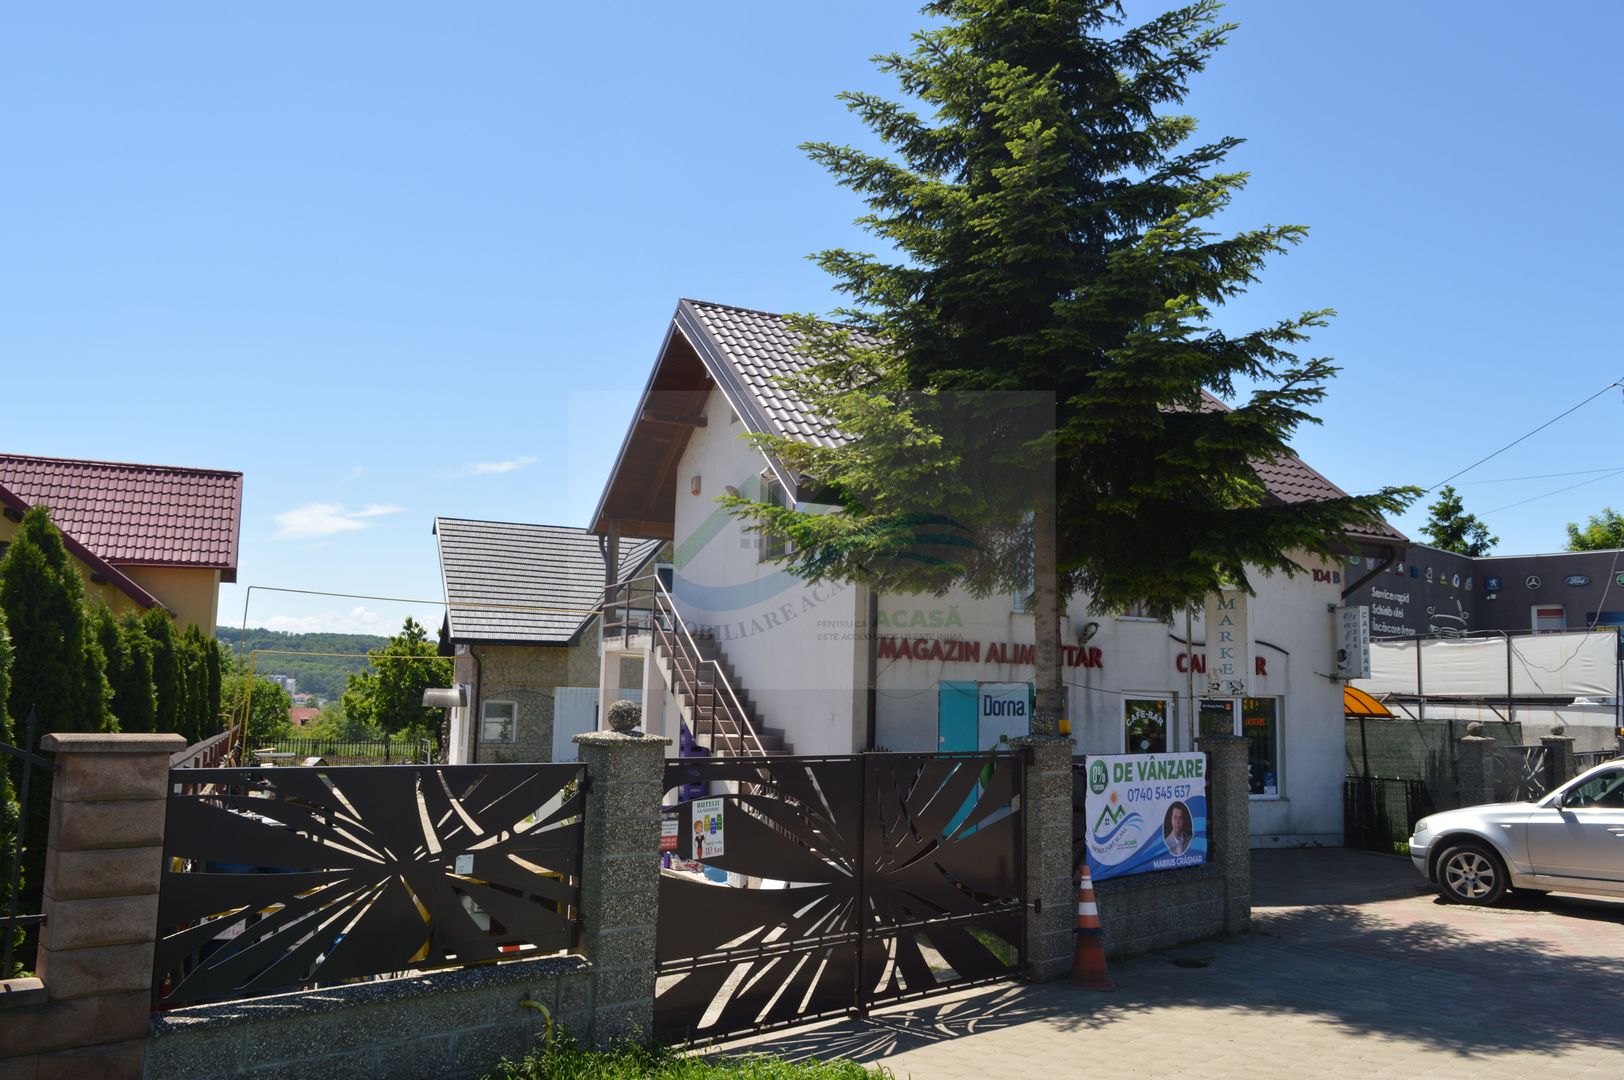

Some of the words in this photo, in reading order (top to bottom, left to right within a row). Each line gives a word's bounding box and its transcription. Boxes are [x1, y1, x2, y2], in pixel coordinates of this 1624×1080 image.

[1312, 568, 1331, 584] 104
[1371, 586, 1394, 601] Service
[878, 637, 981, 663] MAGAZIN
[984, 641, 1104, 669] ALIMTAR
[983, 695, 1025, 717] Dorna
[1126, 710, 1164, 727] CAFE-BAR
[1092, 765, 1106, 784] 0%
[1113, 762, 1133, 783] DE
[1137, 755, 1203, 781] VÂNZARE
[1127, 788, 1153, 802] 0740
[1155, 786, 1172, 800] 545
[1174, 784, 1191, 798] 637
